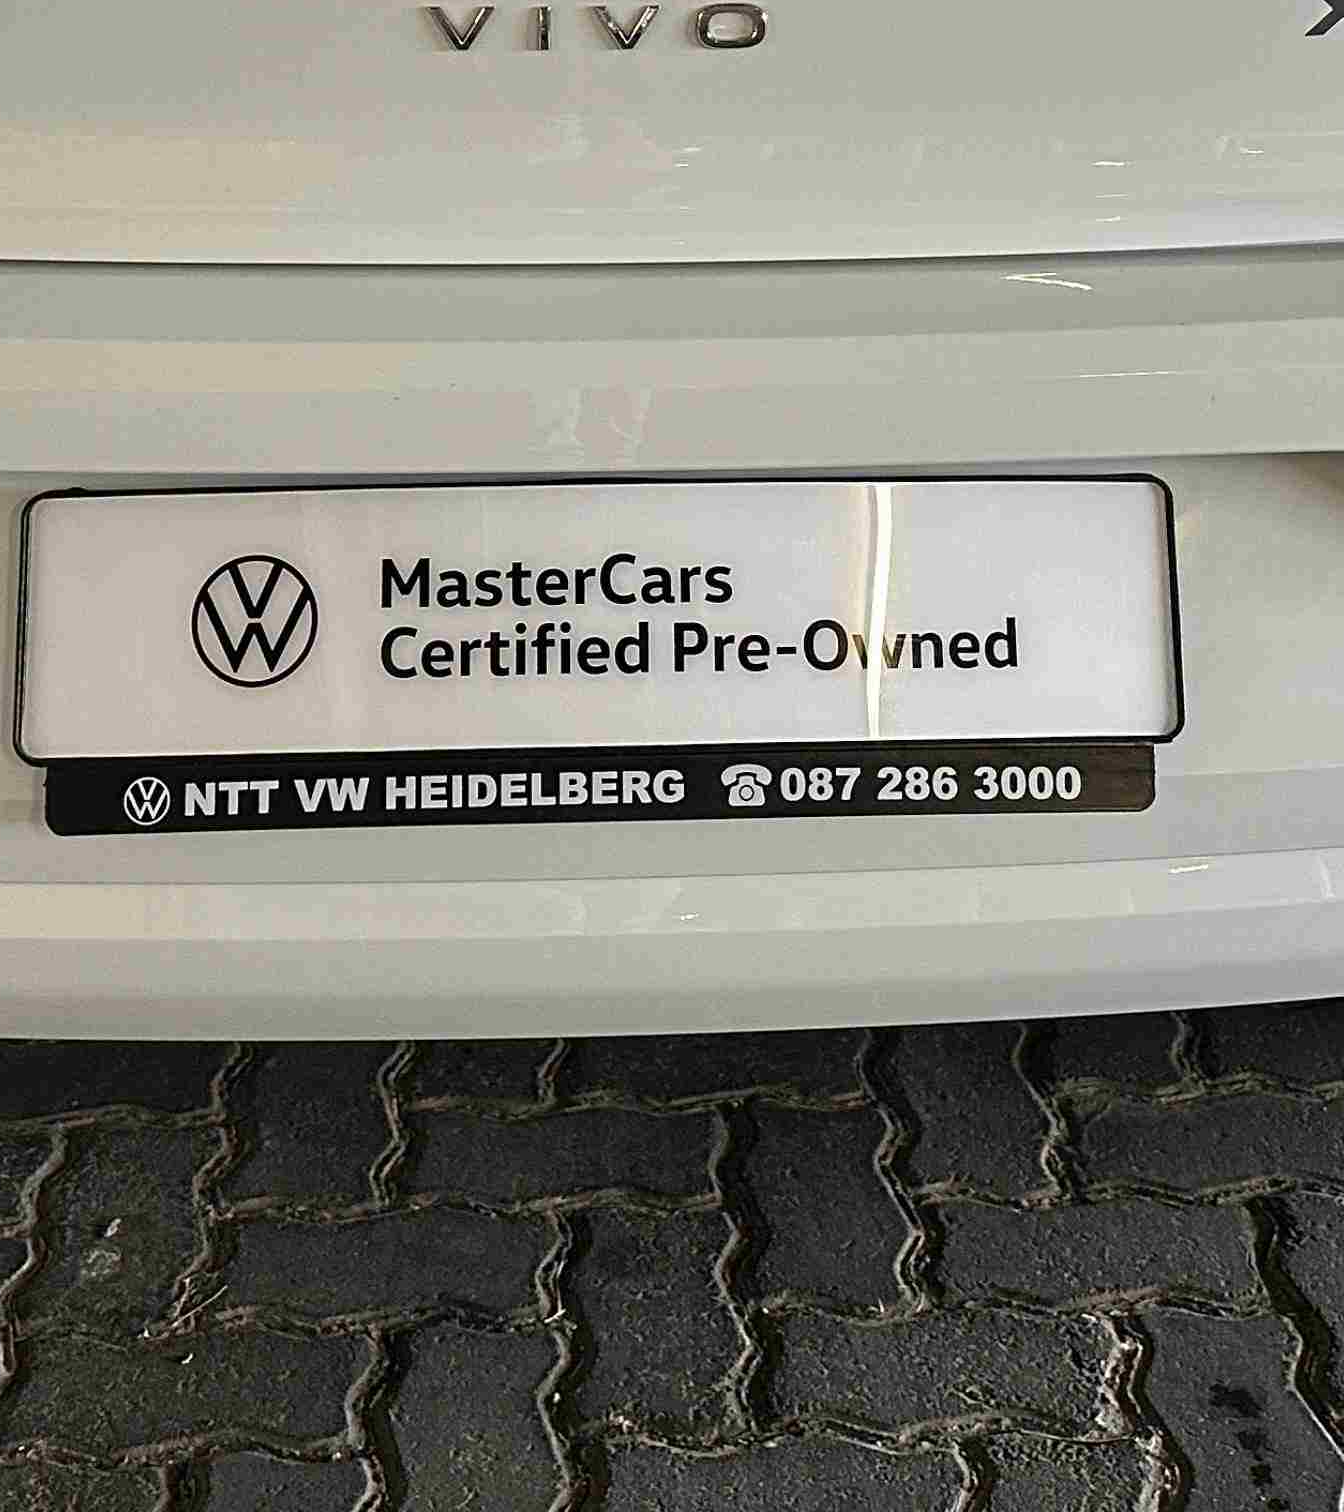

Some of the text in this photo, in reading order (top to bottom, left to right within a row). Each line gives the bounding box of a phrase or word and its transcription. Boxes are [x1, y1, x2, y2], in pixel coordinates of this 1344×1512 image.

[424, 2, 769, 51] VIVO
[380, 552, 734, 609] MasterCars
[380, 617, 1018, 679] Certified Pre-Owned
[183, 779, 279, 817] NTT
[294, 777, 370, 813] VW
[385, 769, 685, 811] HEIDELBERG
[779, 767, 861, 802] 087
[876, 766, 958, 801] 286
[973, 766, 1082, 801] 3000
